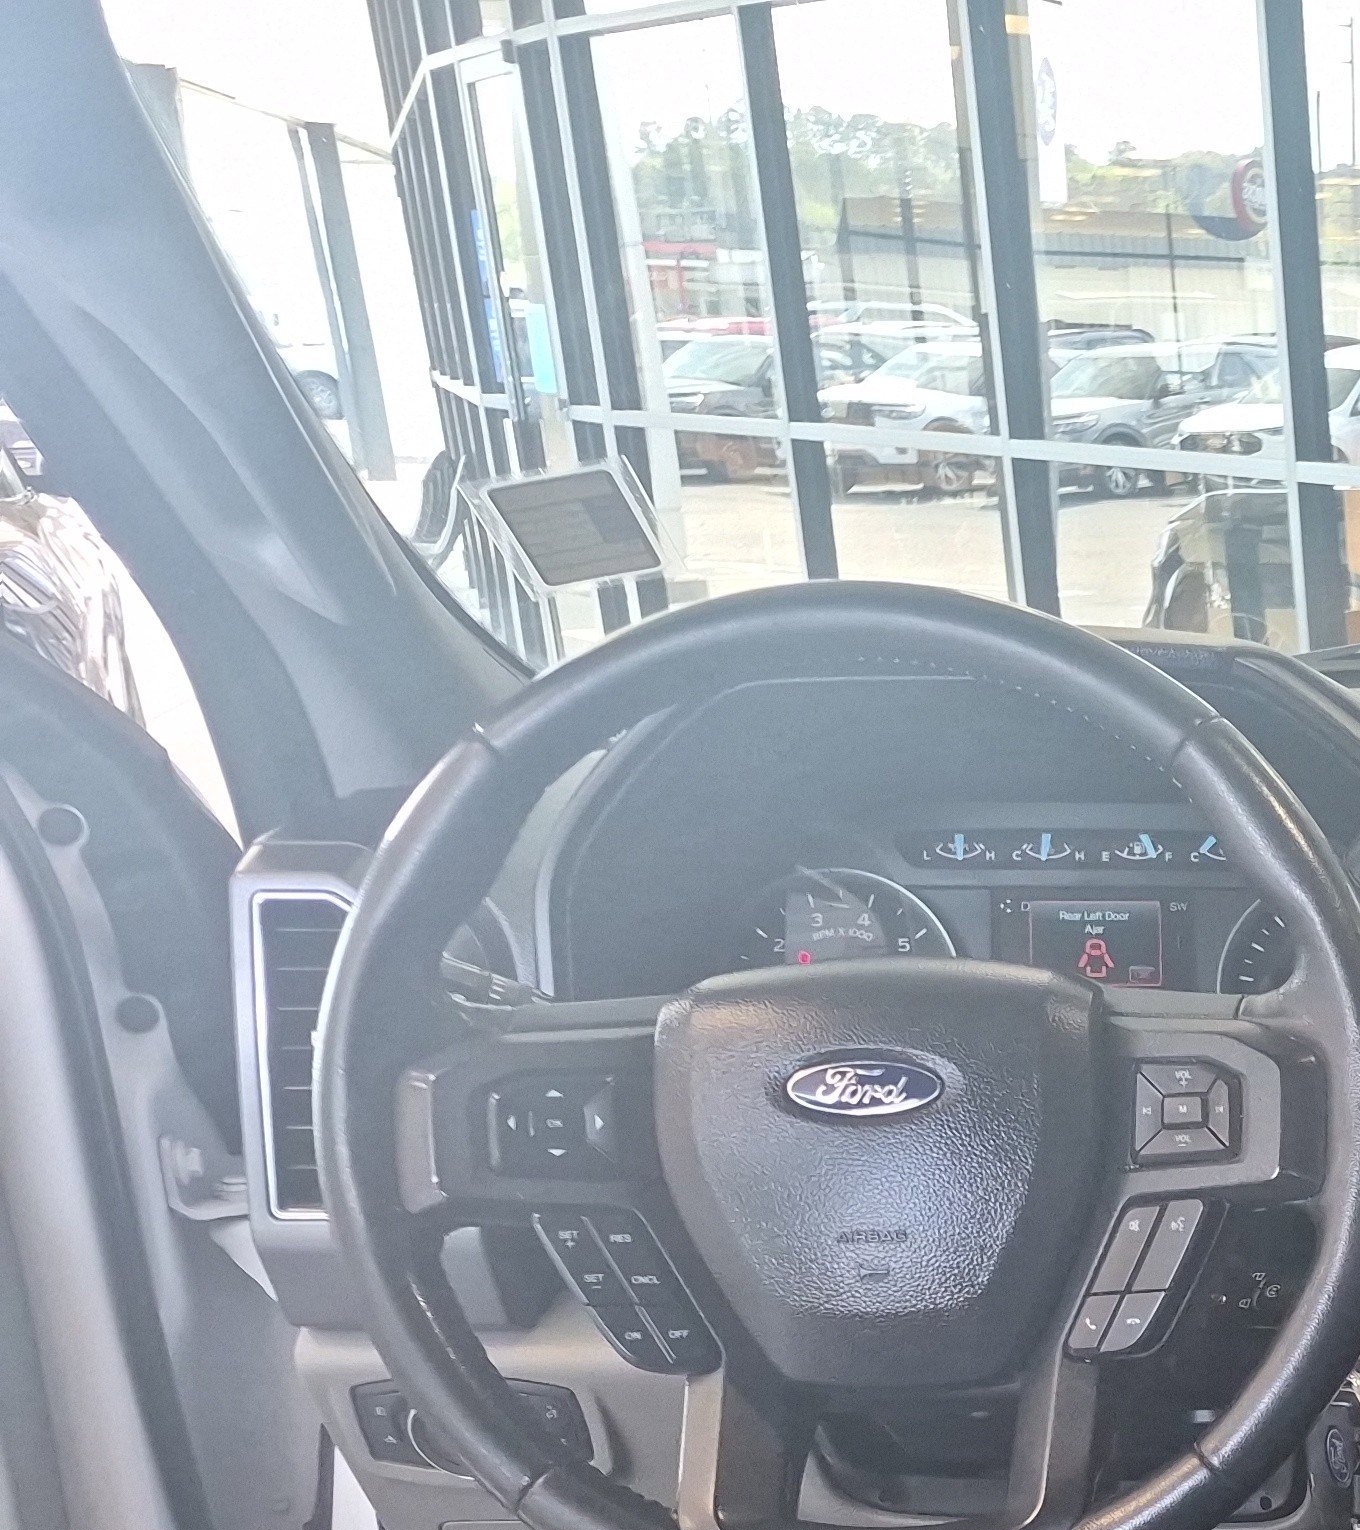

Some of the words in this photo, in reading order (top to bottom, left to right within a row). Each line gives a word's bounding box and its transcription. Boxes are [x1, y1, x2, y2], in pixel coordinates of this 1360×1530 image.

[810, 914, 823, 927] 3
[857, 914, 871, 927] 4
[898, 938, 911, 952] 5
[815, 1066, 909, 1105] Ford
[836, 1229, 908, 1244] AIRBAG
